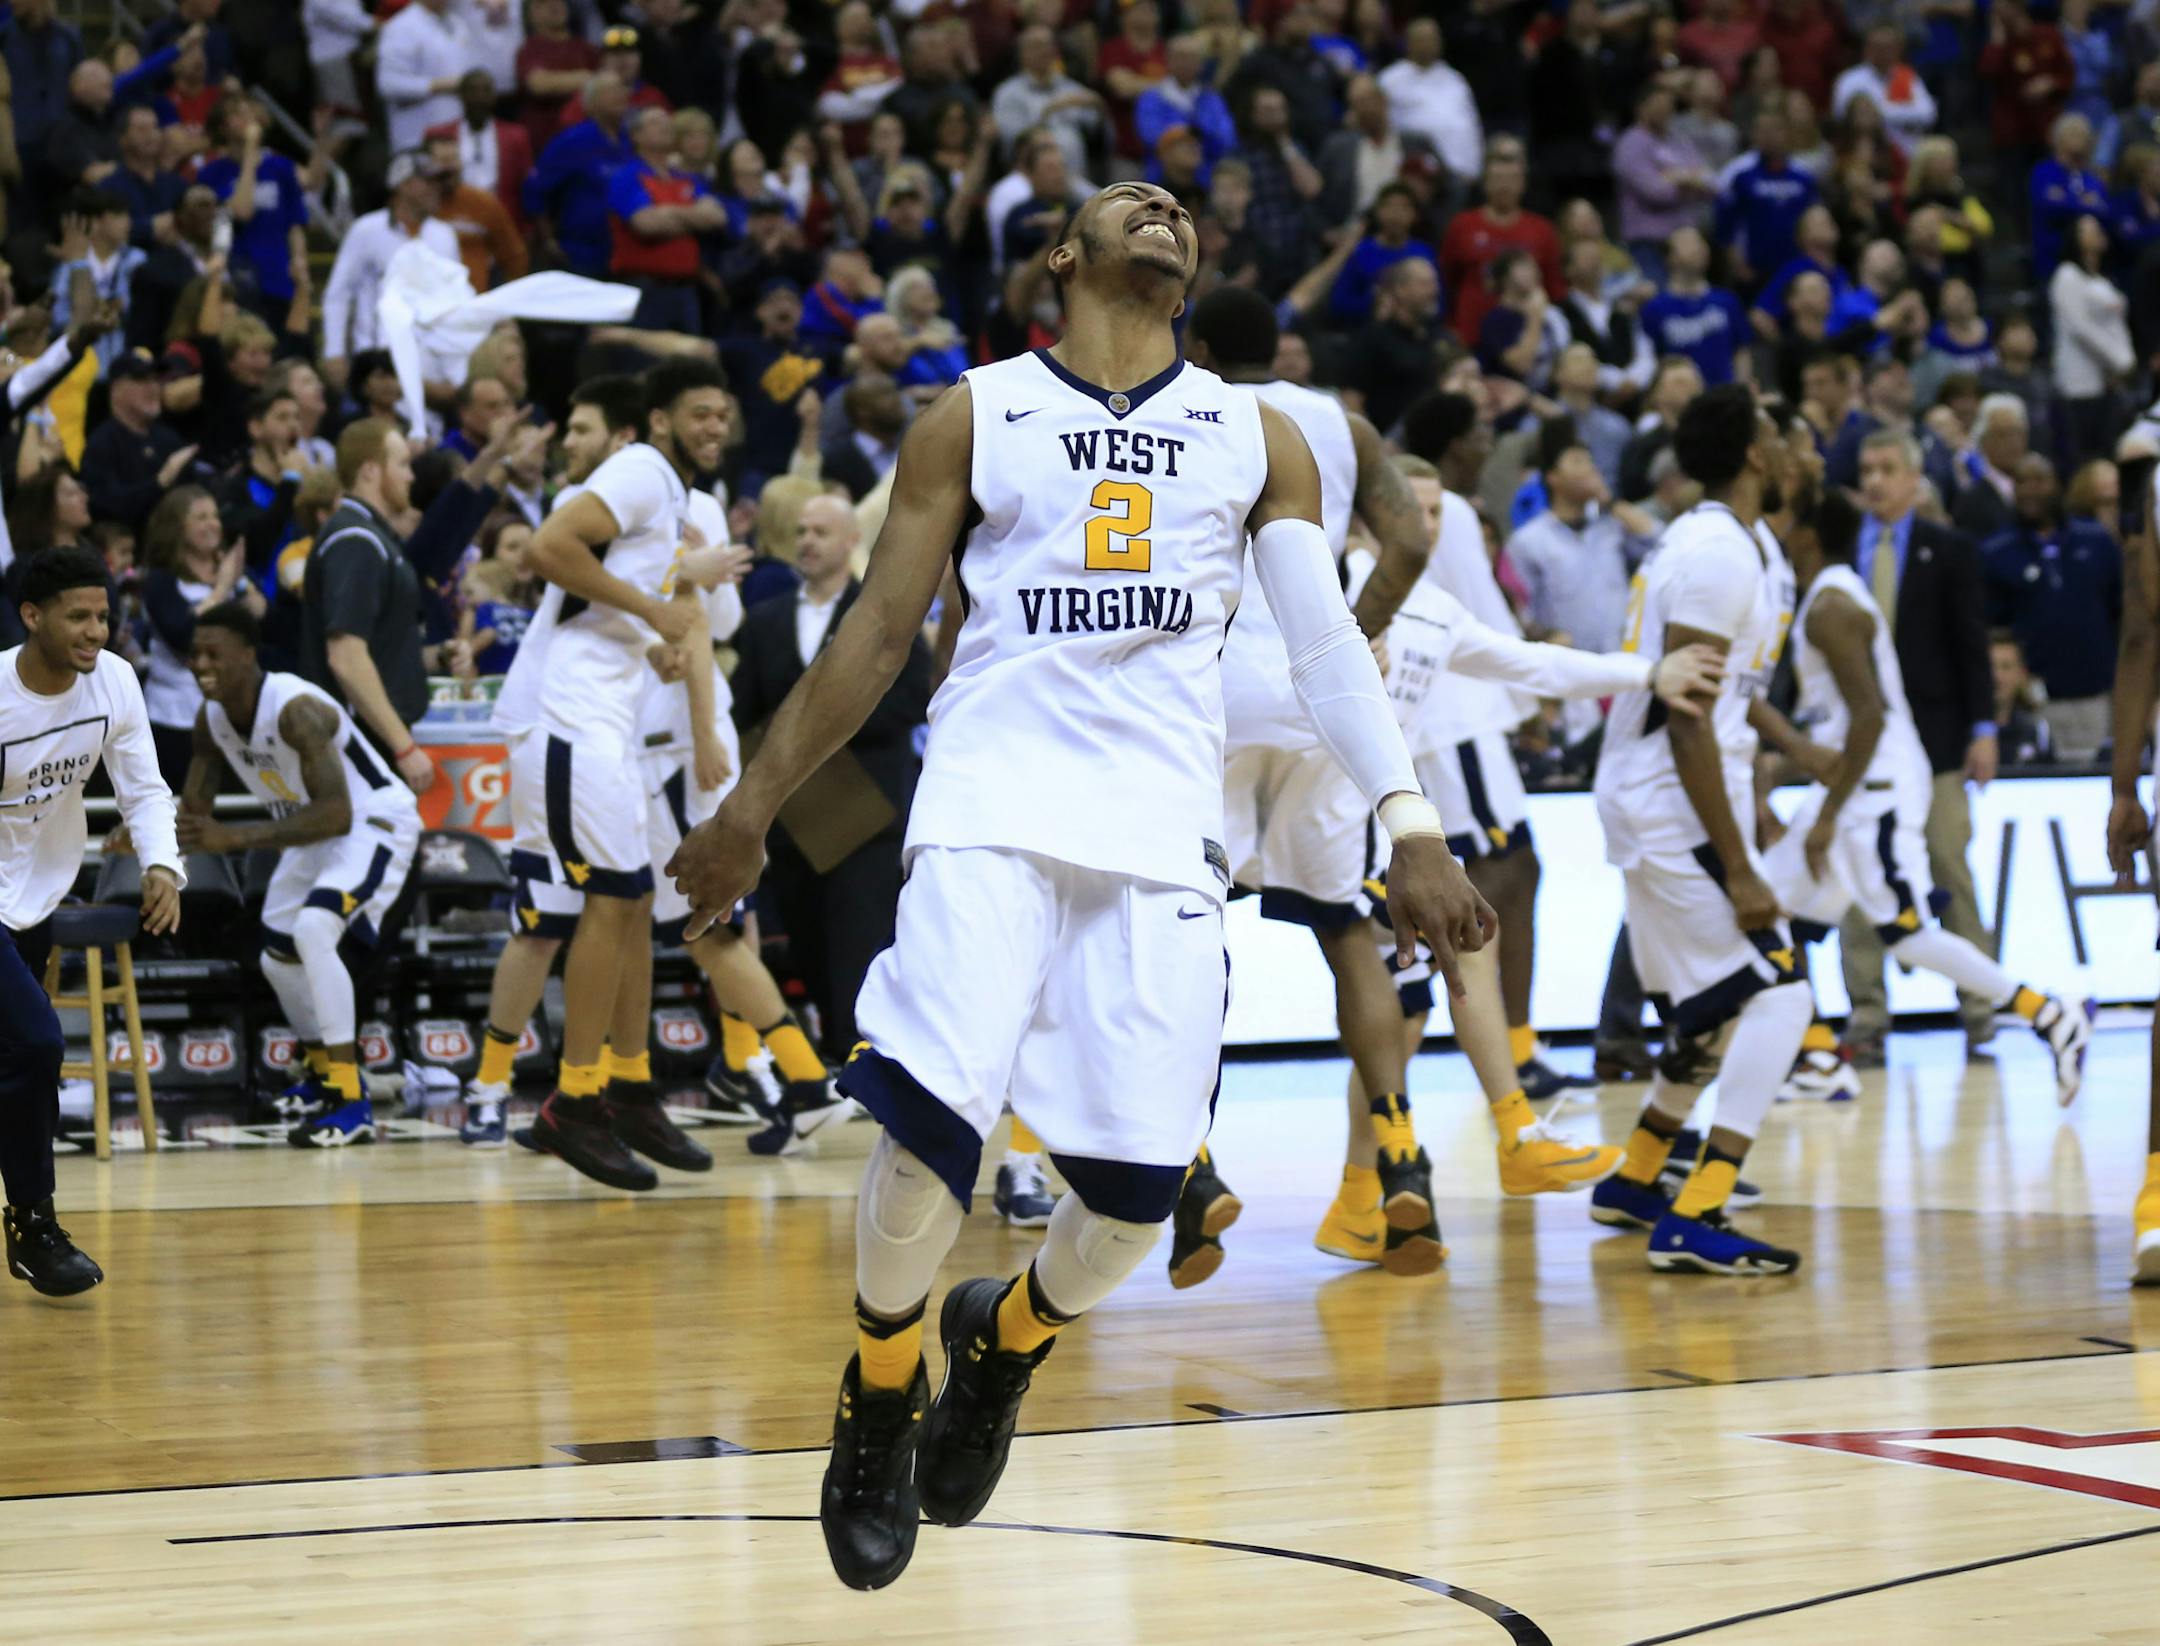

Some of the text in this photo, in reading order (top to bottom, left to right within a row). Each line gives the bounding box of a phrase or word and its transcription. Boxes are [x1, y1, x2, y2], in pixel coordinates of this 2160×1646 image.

[1059, 428, 1185, 477] WEST
[1084, 479, 1152, 573] 2
[1018, 585, 1193, 635] VIRGINIA
[29, 754, 90, 780] BRING
[469, 763, 503, 801] G
[431, 1035, 461, 1053] 66
